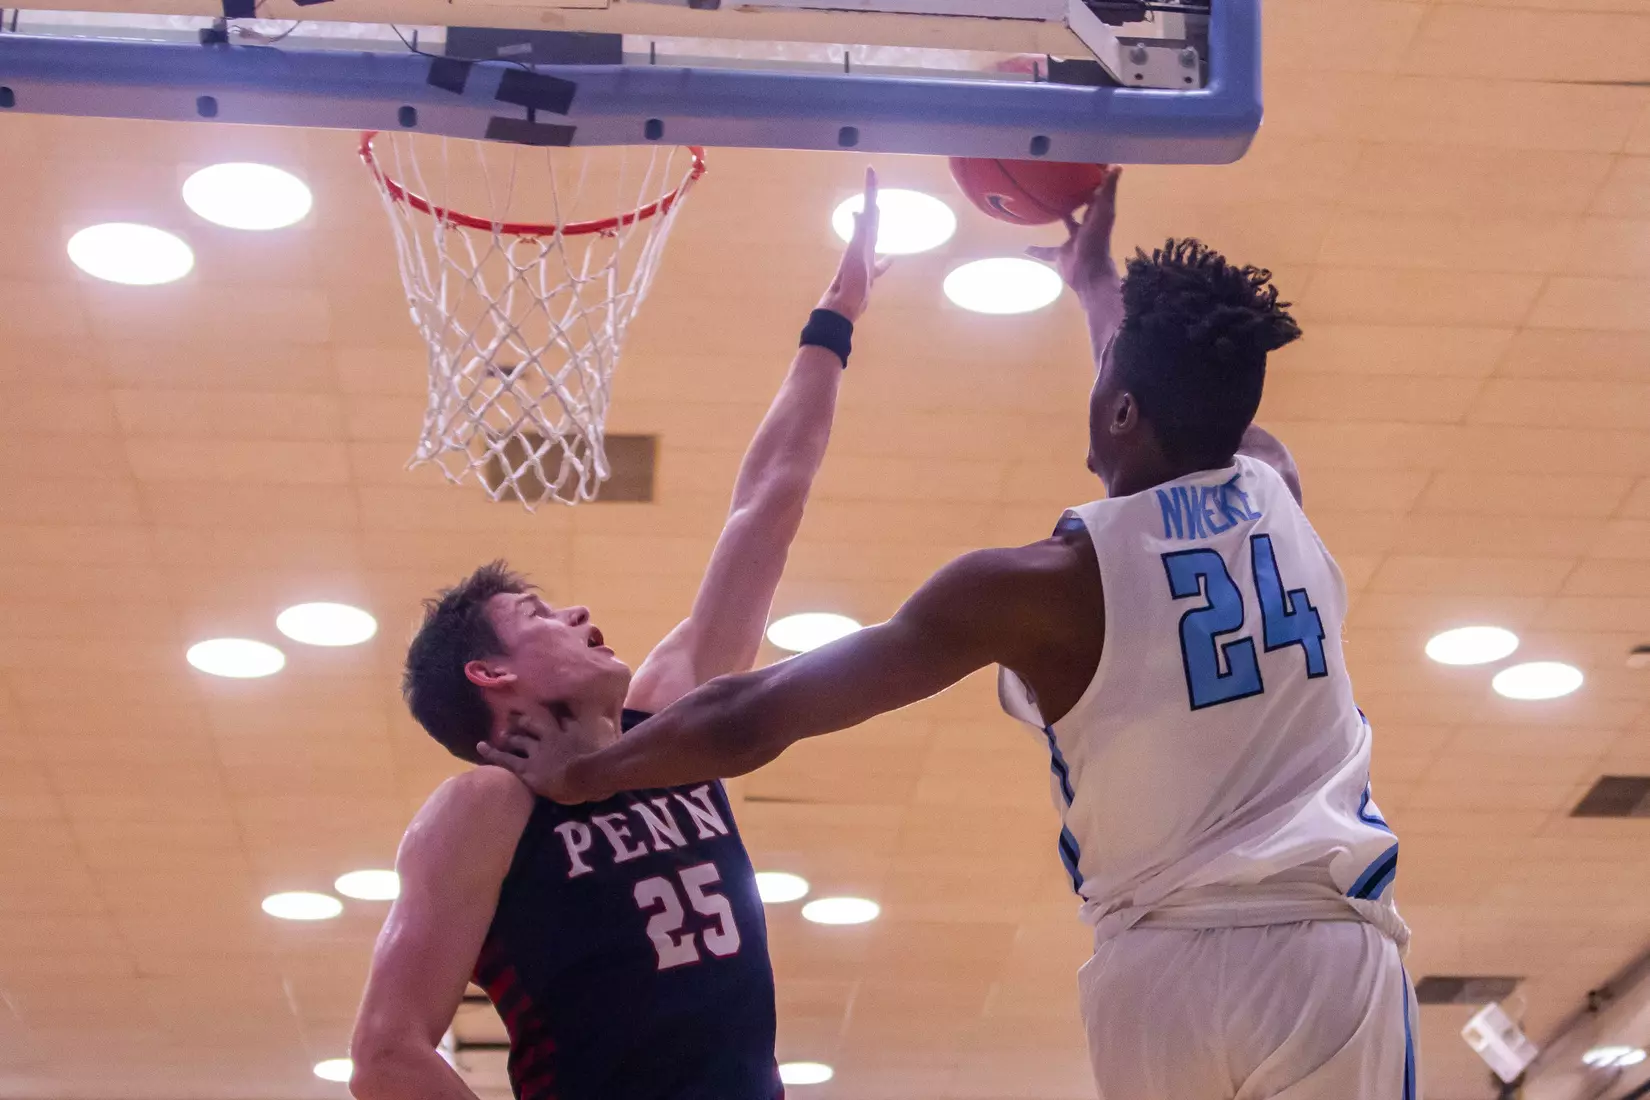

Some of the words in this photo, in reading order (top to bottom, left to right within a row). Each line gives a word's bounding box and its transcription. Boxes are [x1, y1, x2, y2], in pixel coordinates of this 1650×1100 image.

[1160, 533, 1329, 711] 24
[553, 784, 730, 879] PENN
[633, 862, 740, 970] 25
